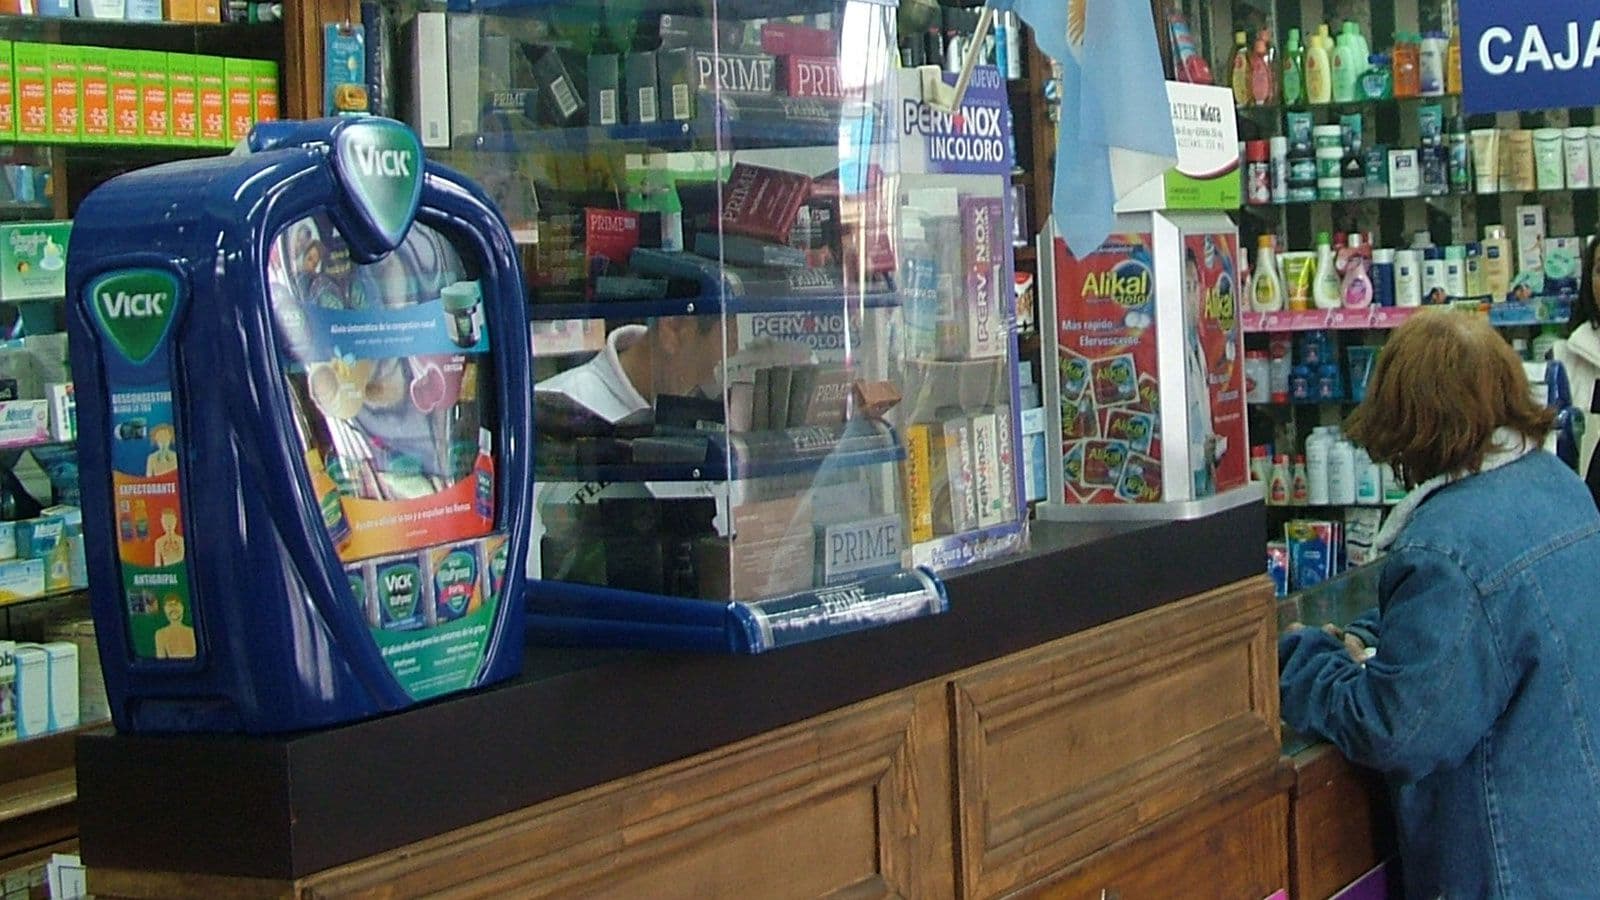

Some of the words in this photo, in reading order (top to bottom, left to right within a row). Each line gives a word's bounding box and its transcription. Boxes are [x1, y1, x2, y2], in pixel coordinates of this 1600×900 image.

[697, 56, 772, 92] PRIME
[354, 143, 410, 176] VICK
[931, 136, 1003, 162] INCOLORO
[724, 167, 760, 222] PRIME
[591, 214, 625, 232] PRIME
[1081, 268, 1148, 299] Alikal
[102, 291, 164, 318] VICK
[119, 482, 176, 496] EXPECTORANTE
[831, 525, 897, 566] PRIME
[133, 573, 178, 585] ANTIGRIPAL
[385, 573, 413, 593] VICK
